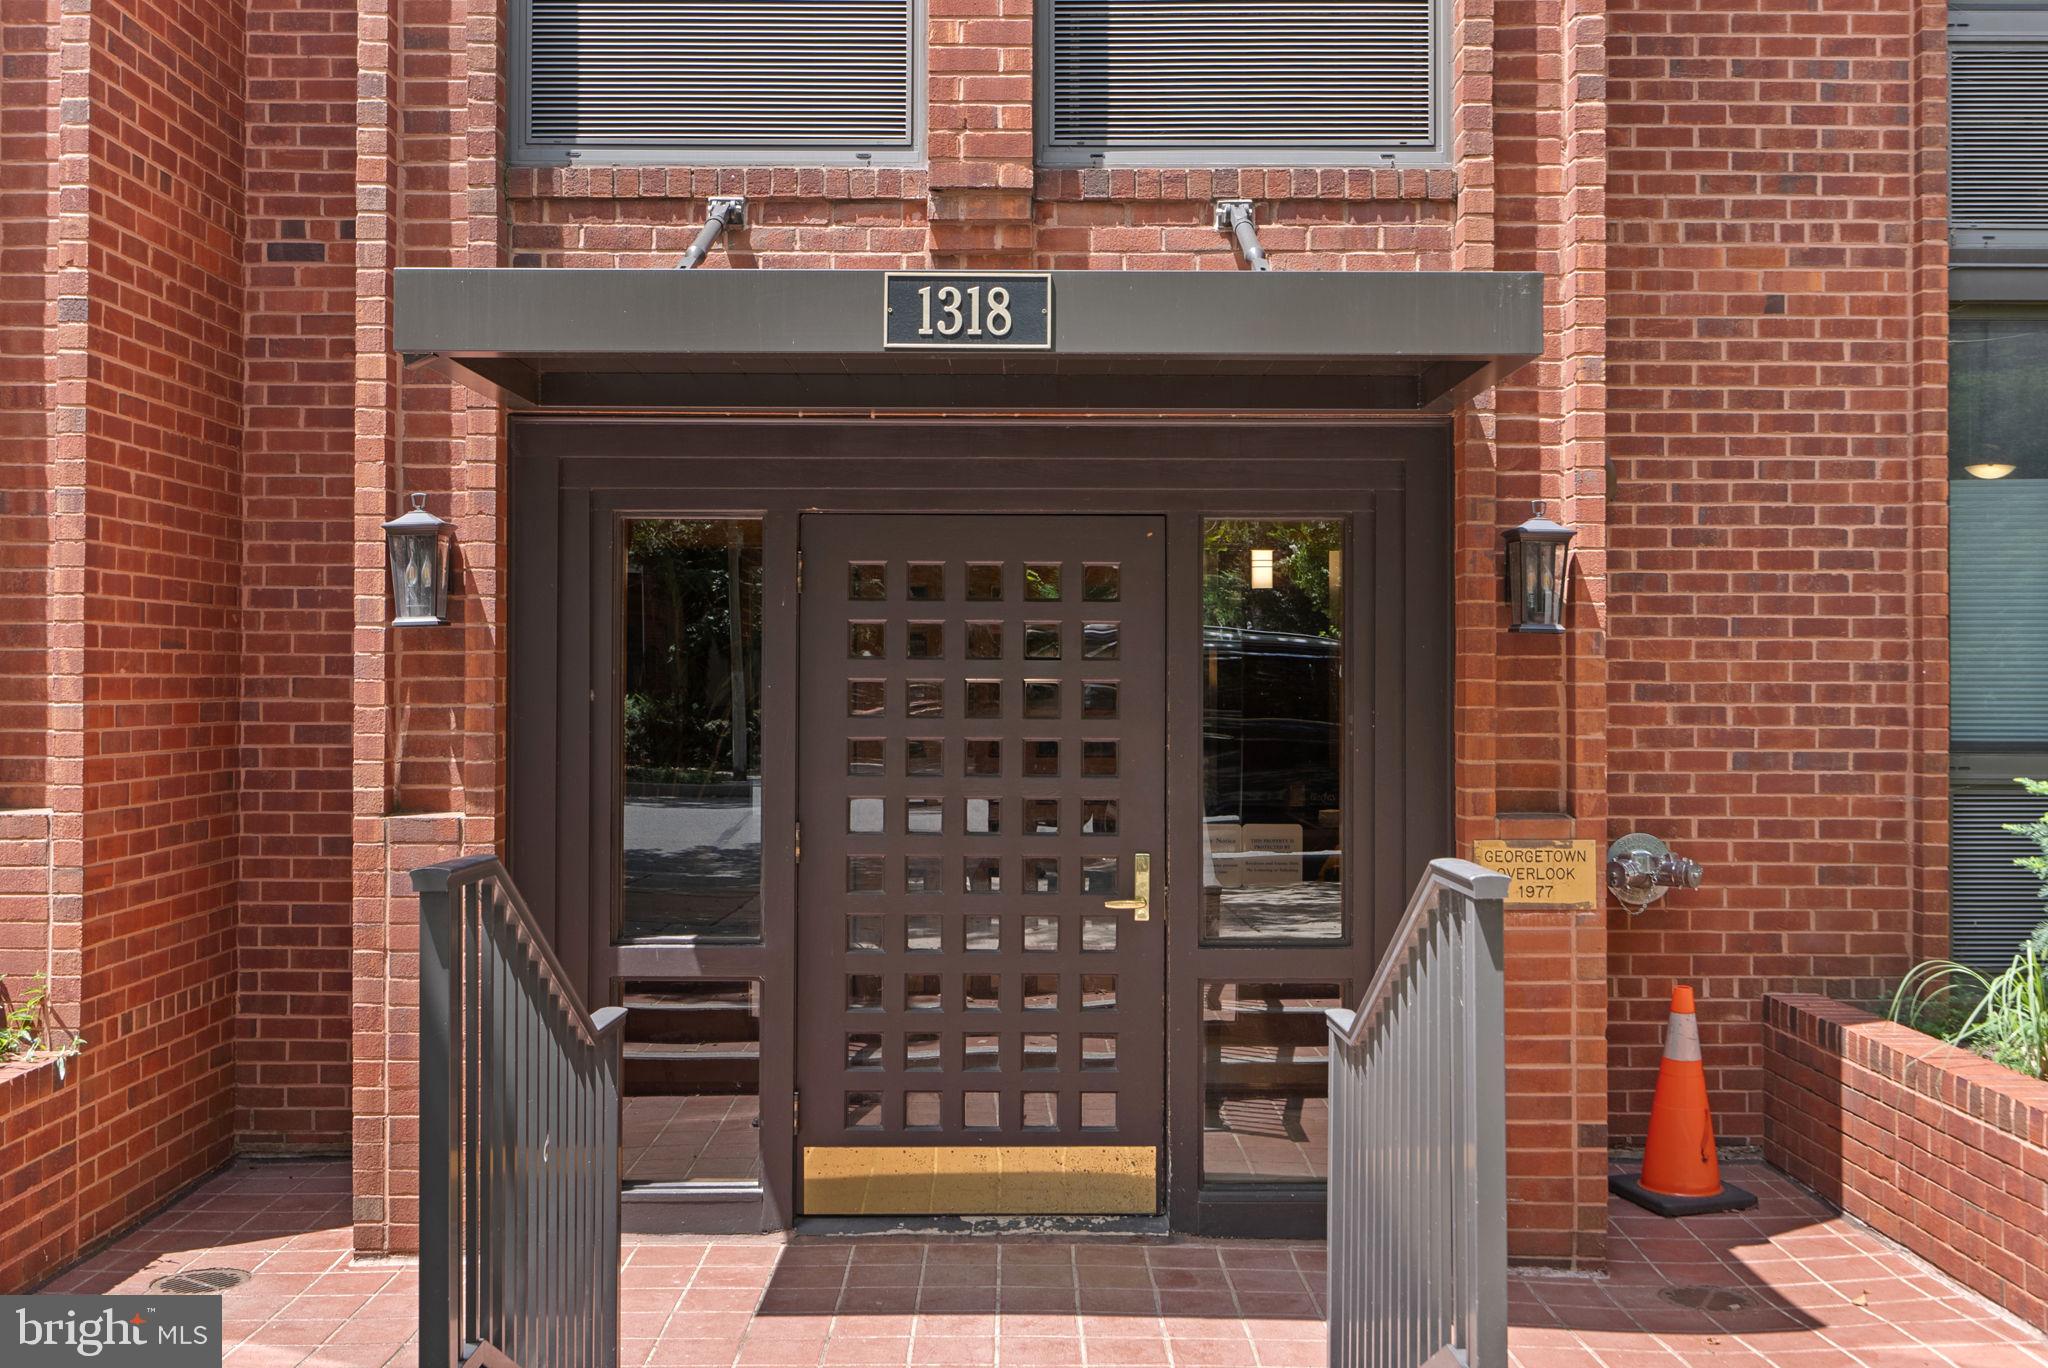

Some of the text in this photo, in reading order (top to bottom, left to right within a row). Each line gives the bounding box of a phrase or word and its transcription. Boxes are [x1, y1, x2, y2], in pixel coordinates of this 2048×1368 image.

[918, 286, 1012, 336] 1318
[1484, 850, 1587, 863] GEORGETOWN
[1518, 885, 1554, 898] 1977
